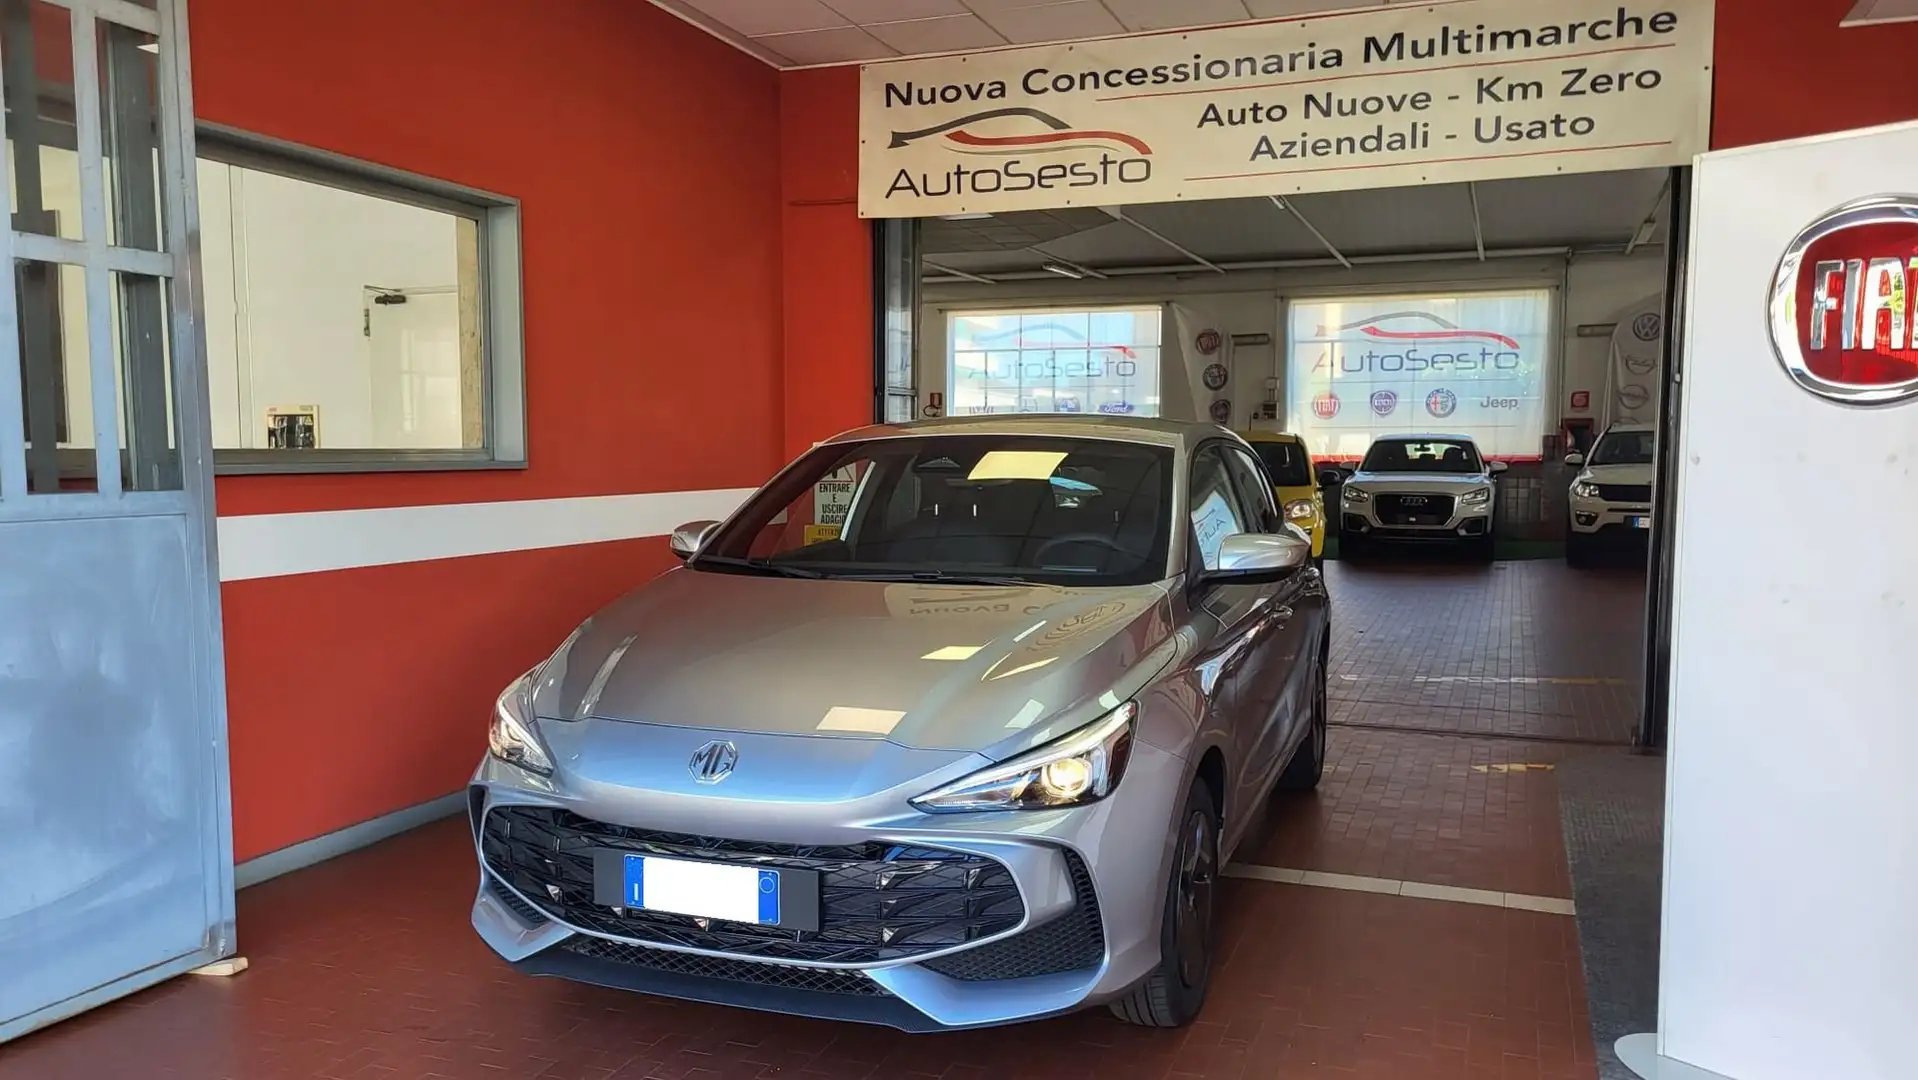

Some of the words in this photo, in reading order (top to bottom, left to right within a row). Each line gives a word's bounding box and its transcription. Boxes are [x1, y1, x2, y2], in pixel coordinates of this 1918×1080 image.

[885, 81, 1007, 108] Nuova
[1021, 42, 1343, 96] Concessionaria
[1363, 7, 1678, 64] Multimarche
[1197, 101, 1288, 129] Auto
[1303, 91, 1432, 120] Nuove
[1476, 75, 1543, 105] Km
[1560, 67, 1662, 98] Zero
[1249, 122, 1430, 162] Aziendali
[1473, 111, 1596, 144] Usato
[884, 152, 1153, 199] AutoSesto
[1809, 257, 1918, 350] FIA
[968, 355, 1137, 379] AutoSesto
[1311, 347, 1520, 373] AutoSesto
[1480, 396, 1518, 409] Jeep
[819, 483, 851, 493] ENTRARE
[832, 493, 838, 503] E
[821, 504, 848, 514] USCIRE
